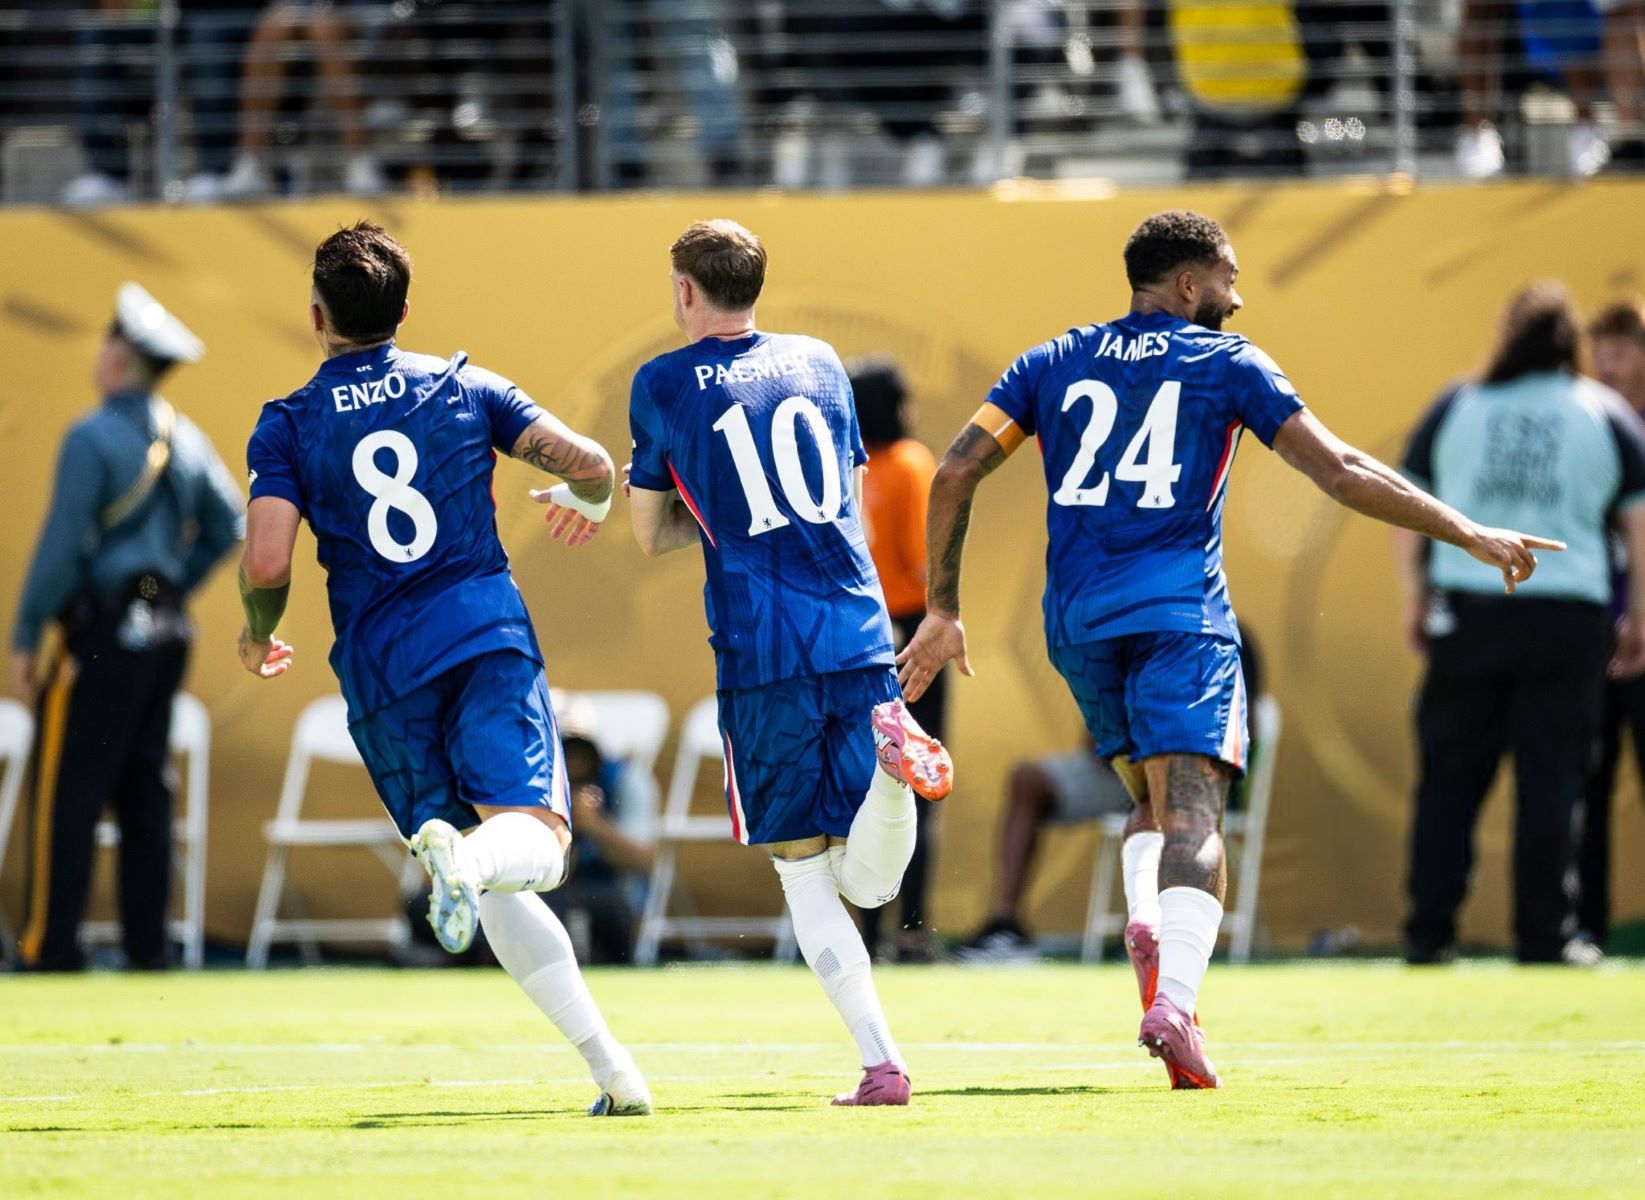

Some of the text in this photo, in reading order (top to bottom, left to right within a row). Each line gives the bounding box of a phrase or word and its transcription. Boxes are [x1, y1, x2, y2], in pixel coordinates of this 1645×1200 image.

[331, 371, 406, 413] ENZO
[1094, 331, 1171, 361] JAMES
[352, 429, 437, 563] 8
[712, 395, 842, 537] 10
[1053, 379, 1182, 508] 24
